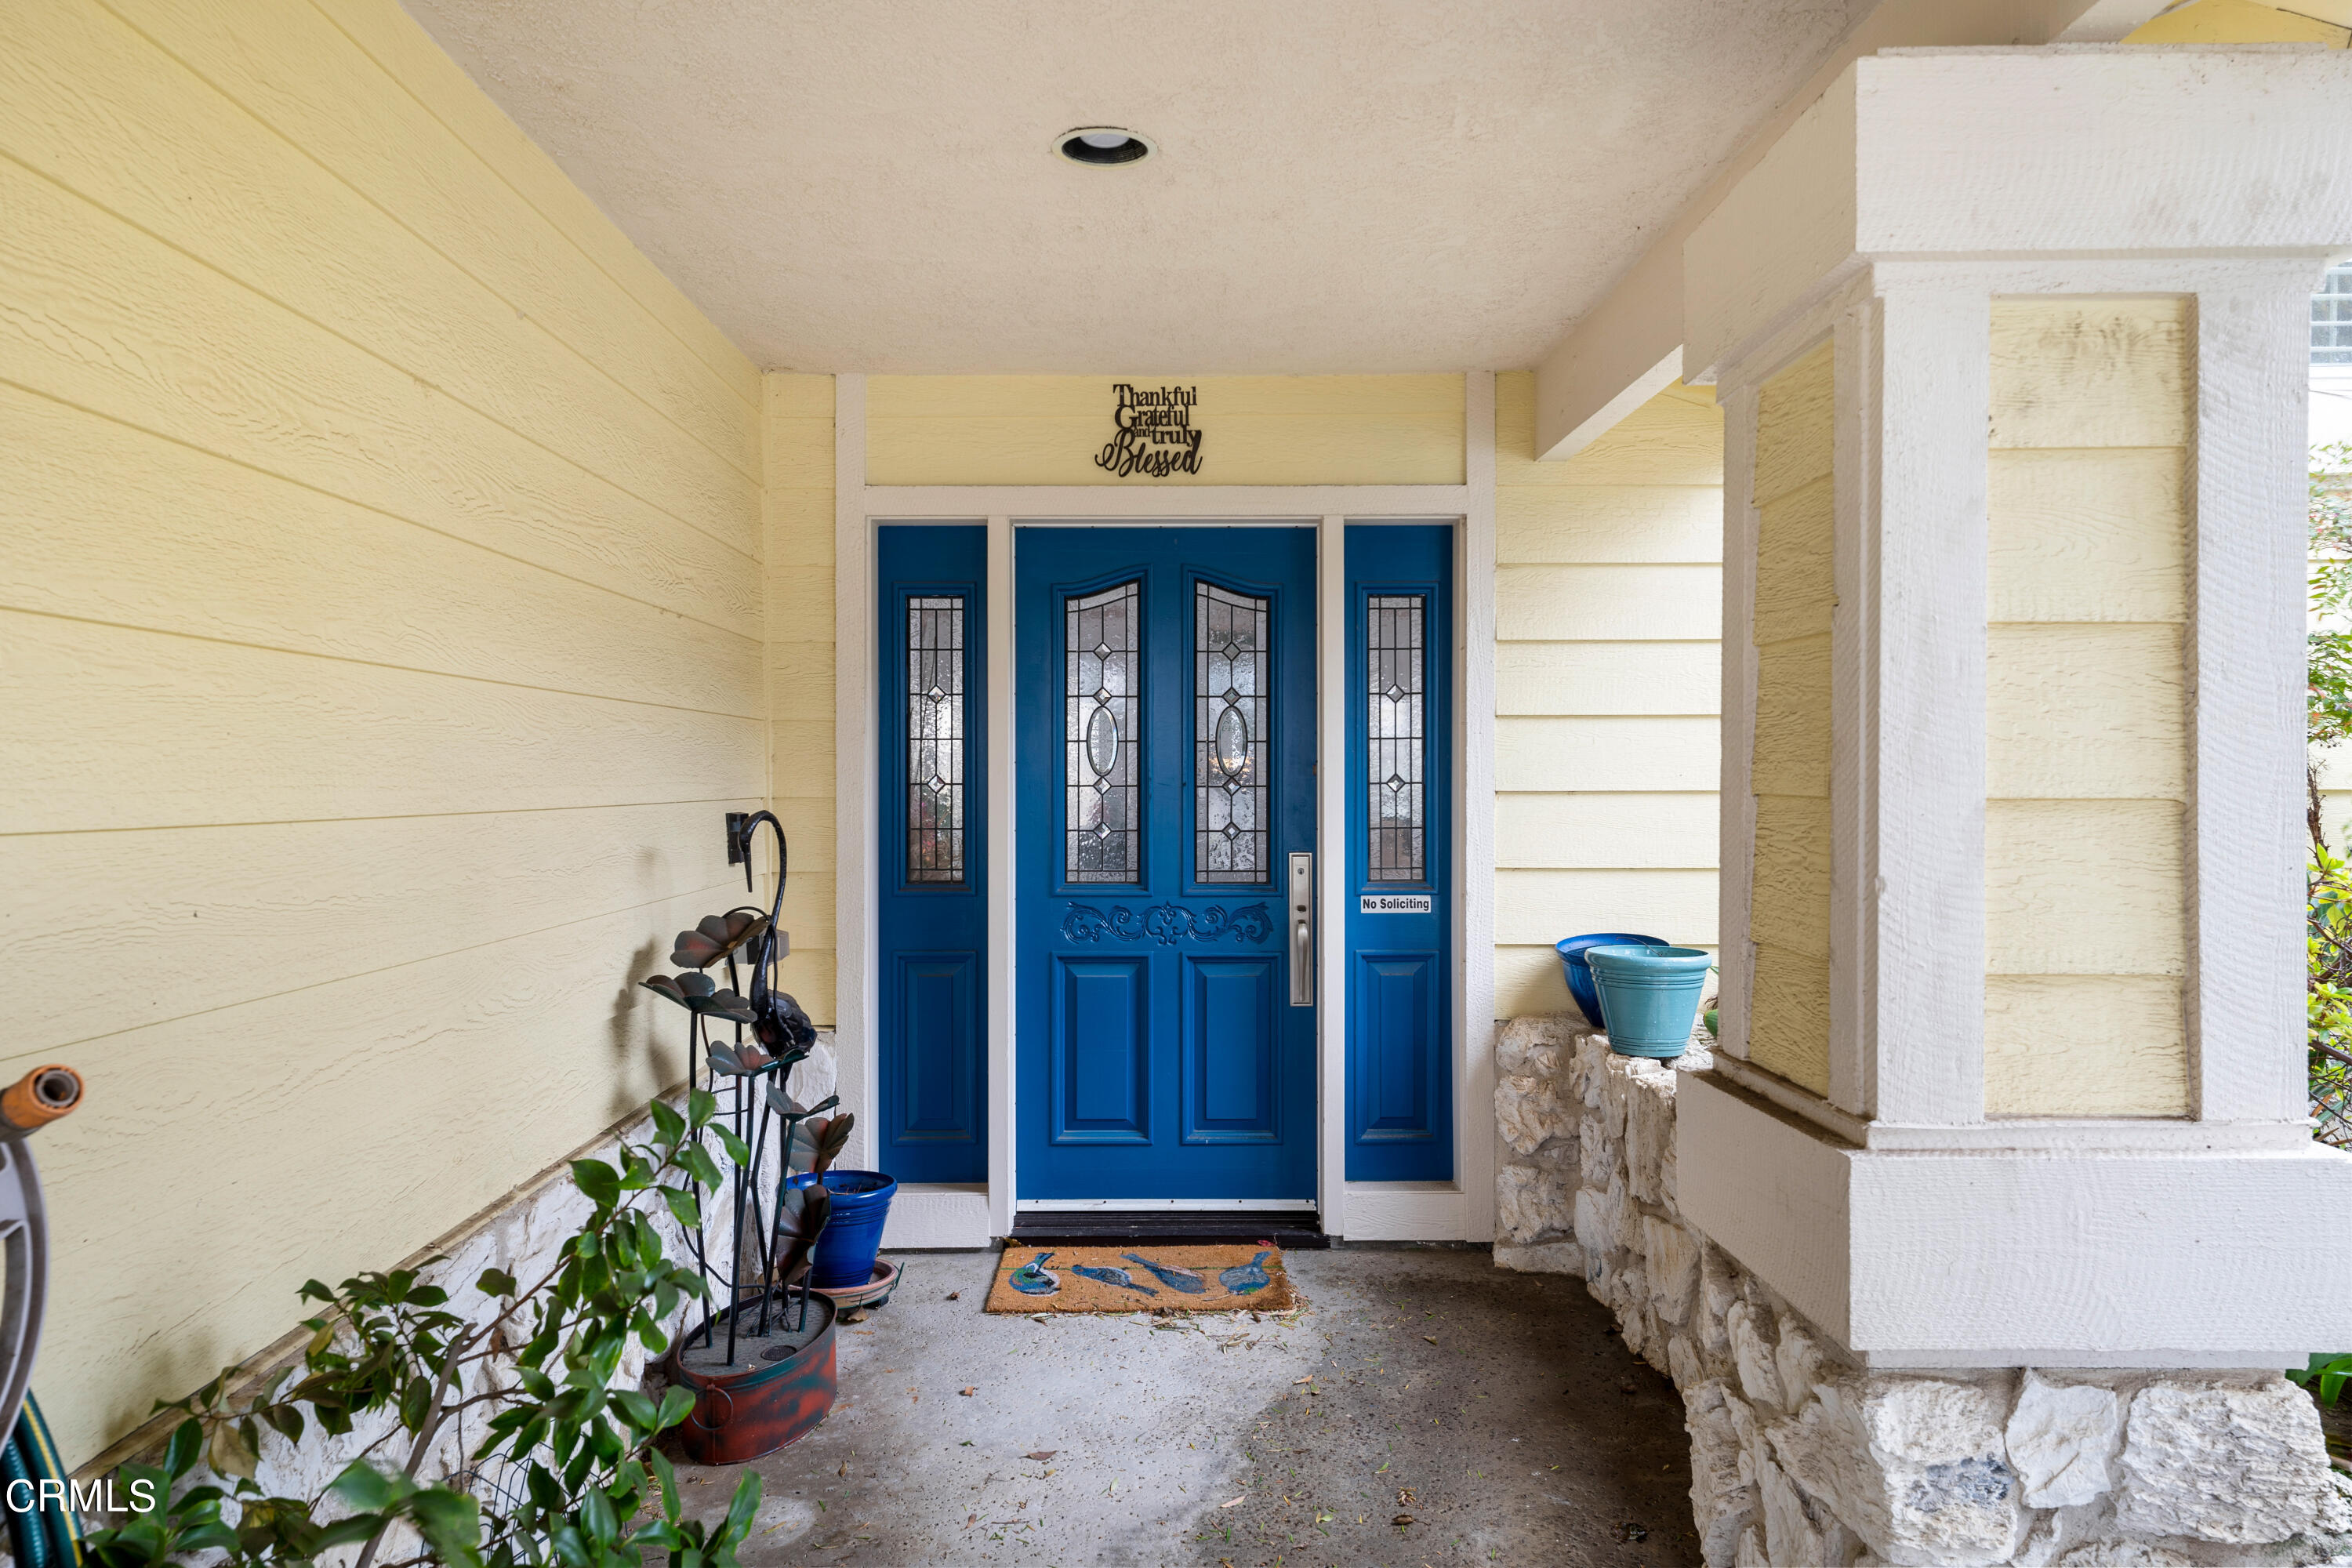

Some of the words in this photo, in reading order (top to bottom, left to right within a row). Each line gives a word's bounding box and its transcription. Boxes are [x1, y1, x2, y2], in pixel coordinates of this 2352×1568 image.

[1113, 384, 1197, 407] Thankful
[1114, 405, 1189, 429] Grateful
[1134, 426, 1150, 437] and
[1152, 424, 1202, 447] truly
[1094, 427, 1203, 477] Blessed
[1363, 898, 1377, 909] No
[1380, 898, 1429, 911] Soliciting
